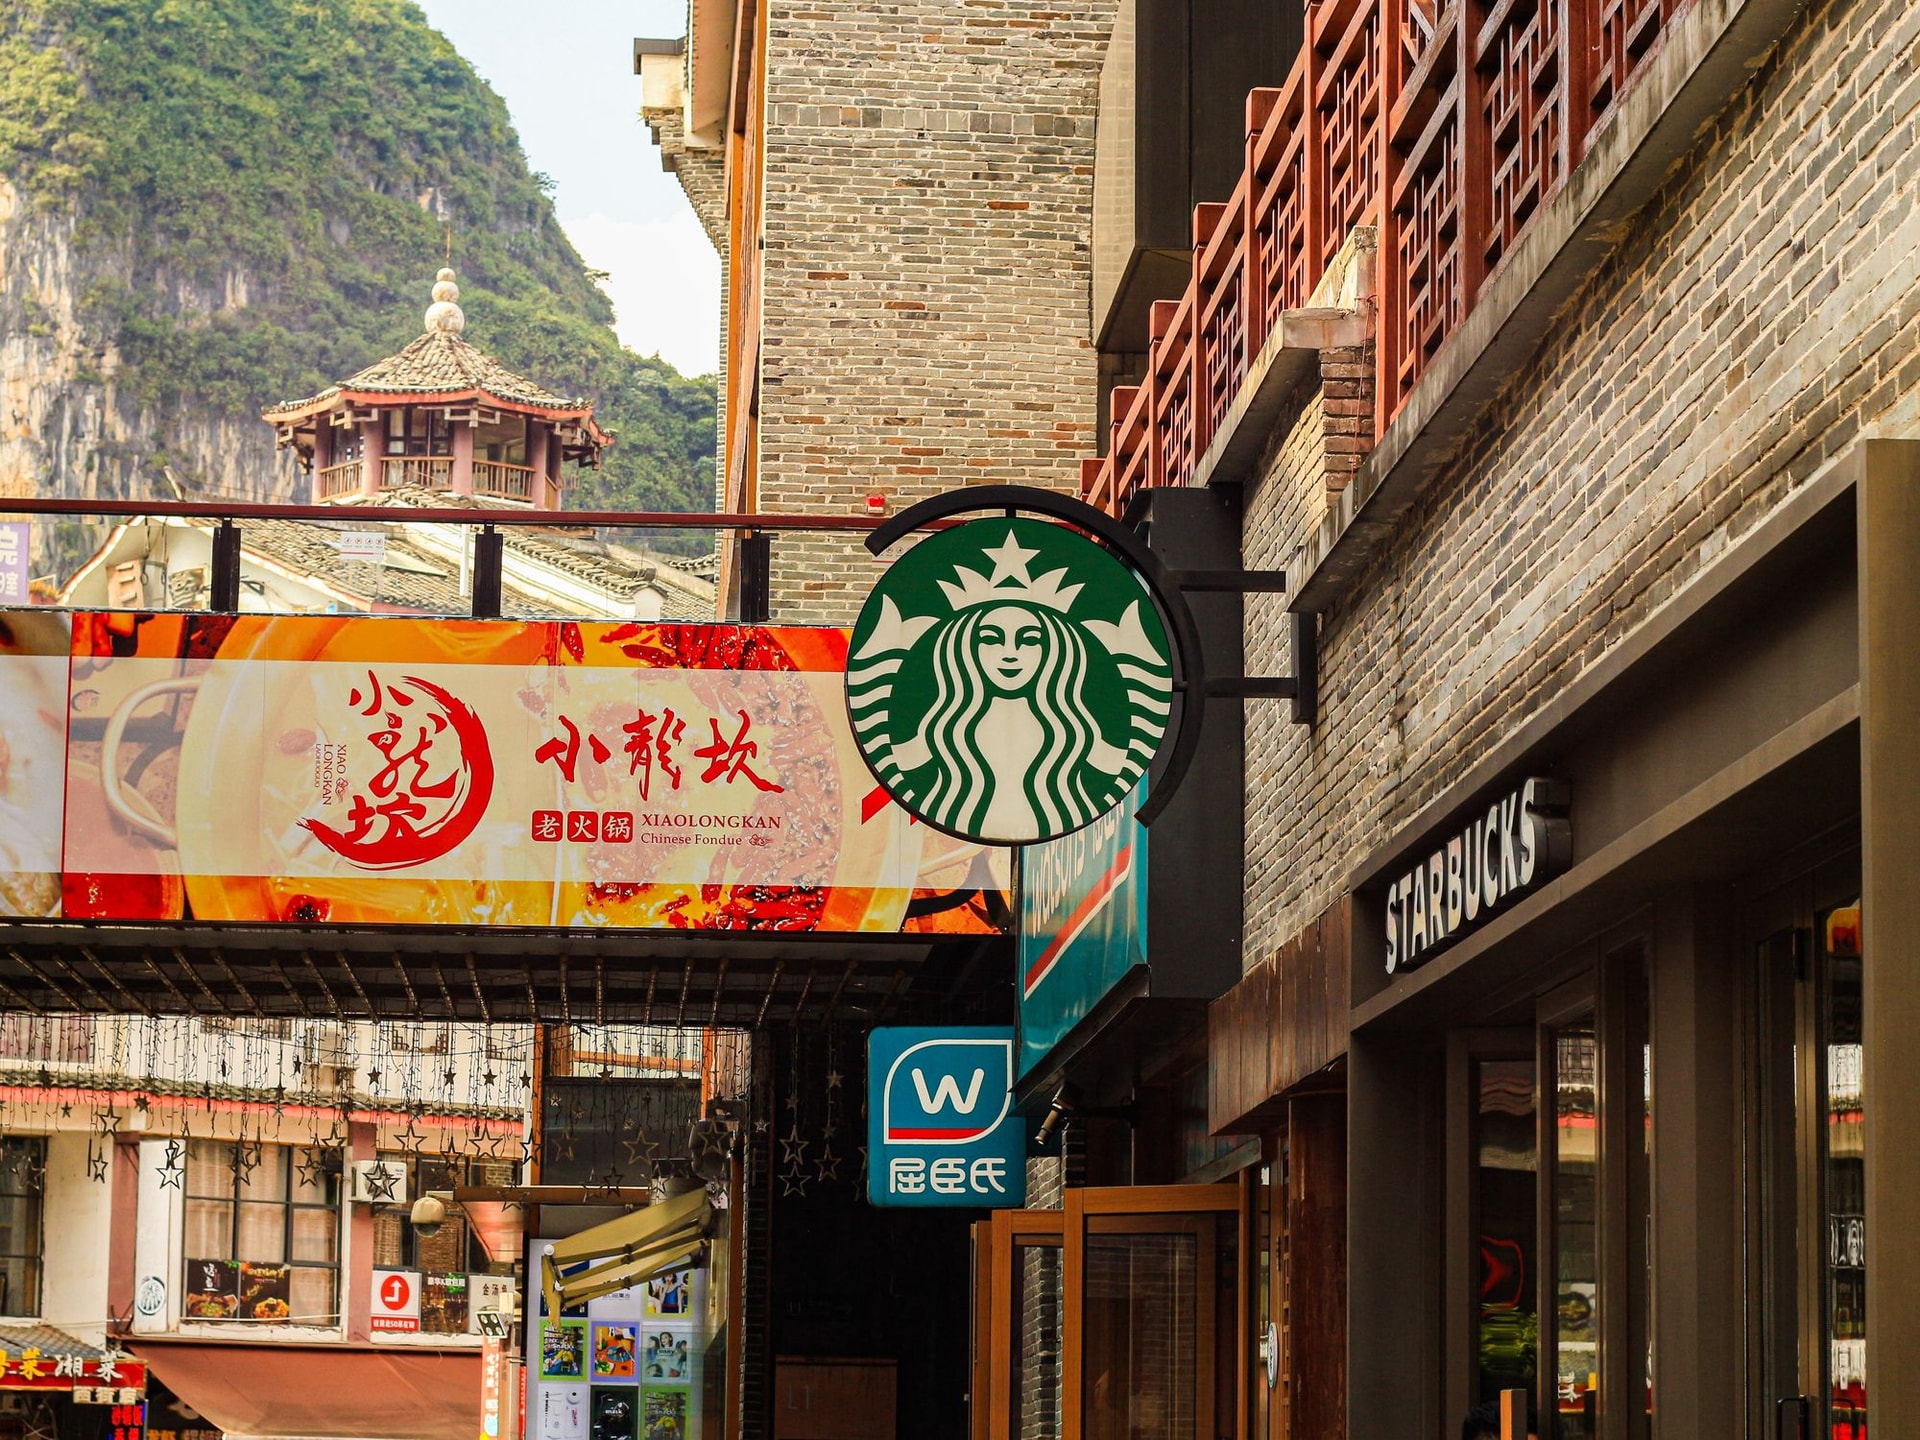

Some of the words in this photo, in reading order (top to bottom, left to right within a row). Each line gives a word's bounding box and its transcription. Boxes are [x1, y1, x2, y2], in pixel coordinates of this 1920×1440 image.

[323, 744, 334, 806] LONGKAN
[336, 744, 347, 774] XIAO
[534, 812, 632, 841] 老火锅
[641, 813, 782, 829] XIAOLONGKAN
[640, 832, 692, 845] Chinese
[695, 833, 743, 846] Fondue
[1385, 778, 1536, 975] STARBUCKS
[911, 1067, 985, 1115] W
[889, 1157, 1006, 1194] 屈臣氏
